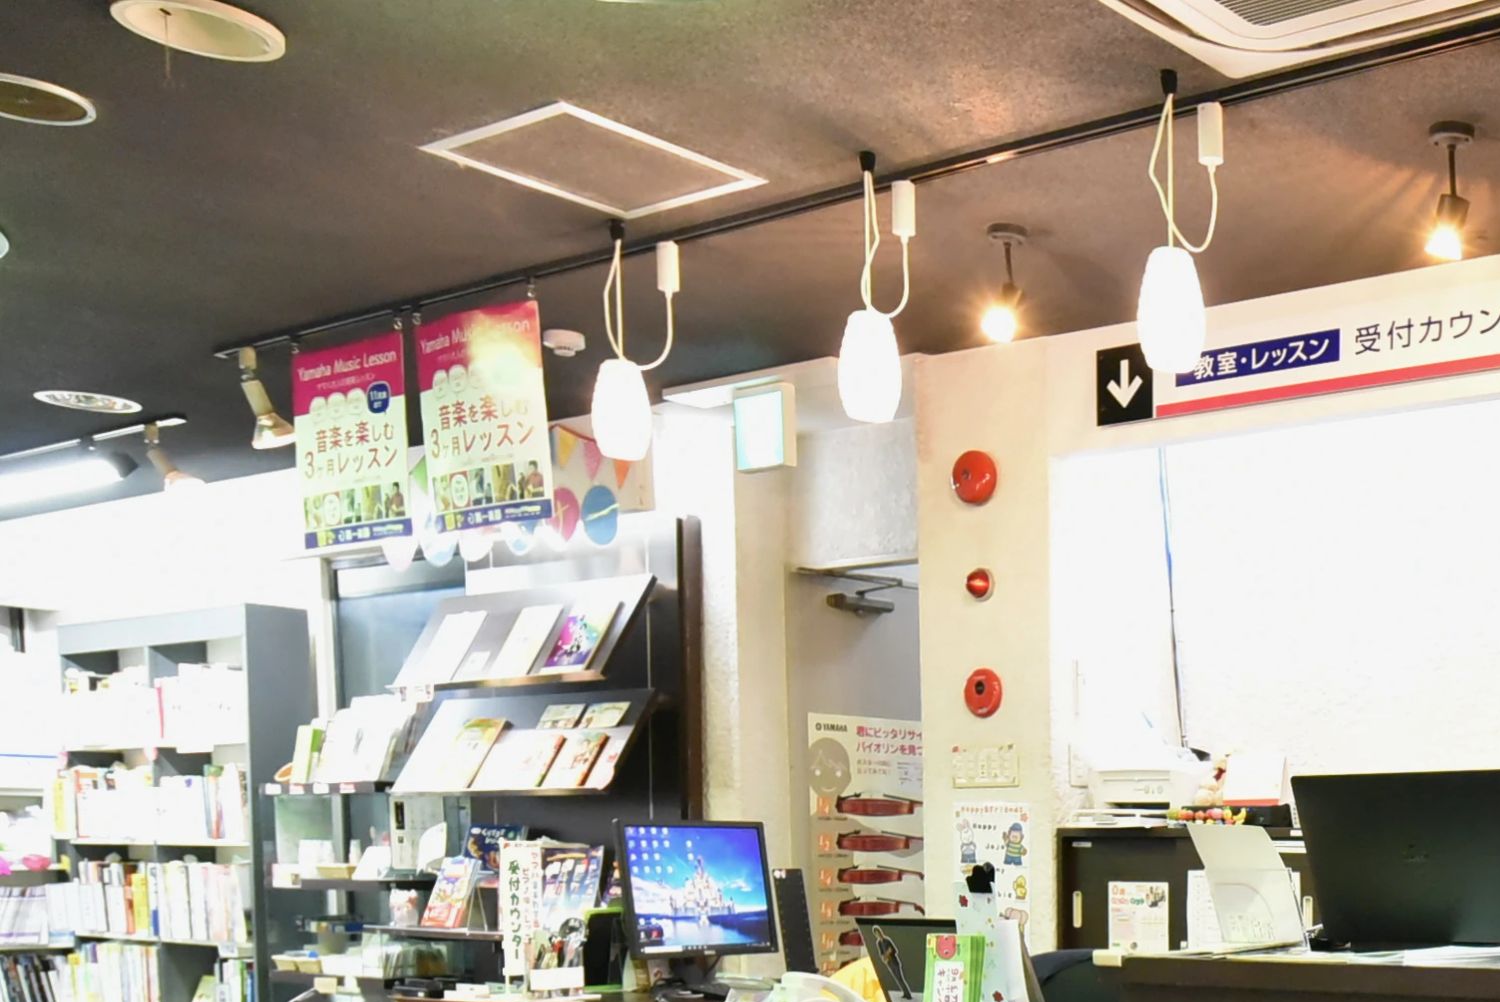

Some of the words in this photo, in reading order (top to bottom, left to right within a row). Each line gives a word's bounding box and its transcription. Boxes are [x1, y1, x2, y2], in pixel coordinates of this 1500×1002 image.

[420, 334, 450, 355] Yamaha
[1193, 337, 1331, 380] 教室・レッスン
[297, 363, 332, 381] Yamaha
[333, 355, 362, 374] Music
[363, 351, 397, 368] Lesson
[315, 421, 394, 453] 音楽を楽しむ
[823, 723, 848, 732] YAMAHA
[508, 859, 522, 960] 受付カウンター
